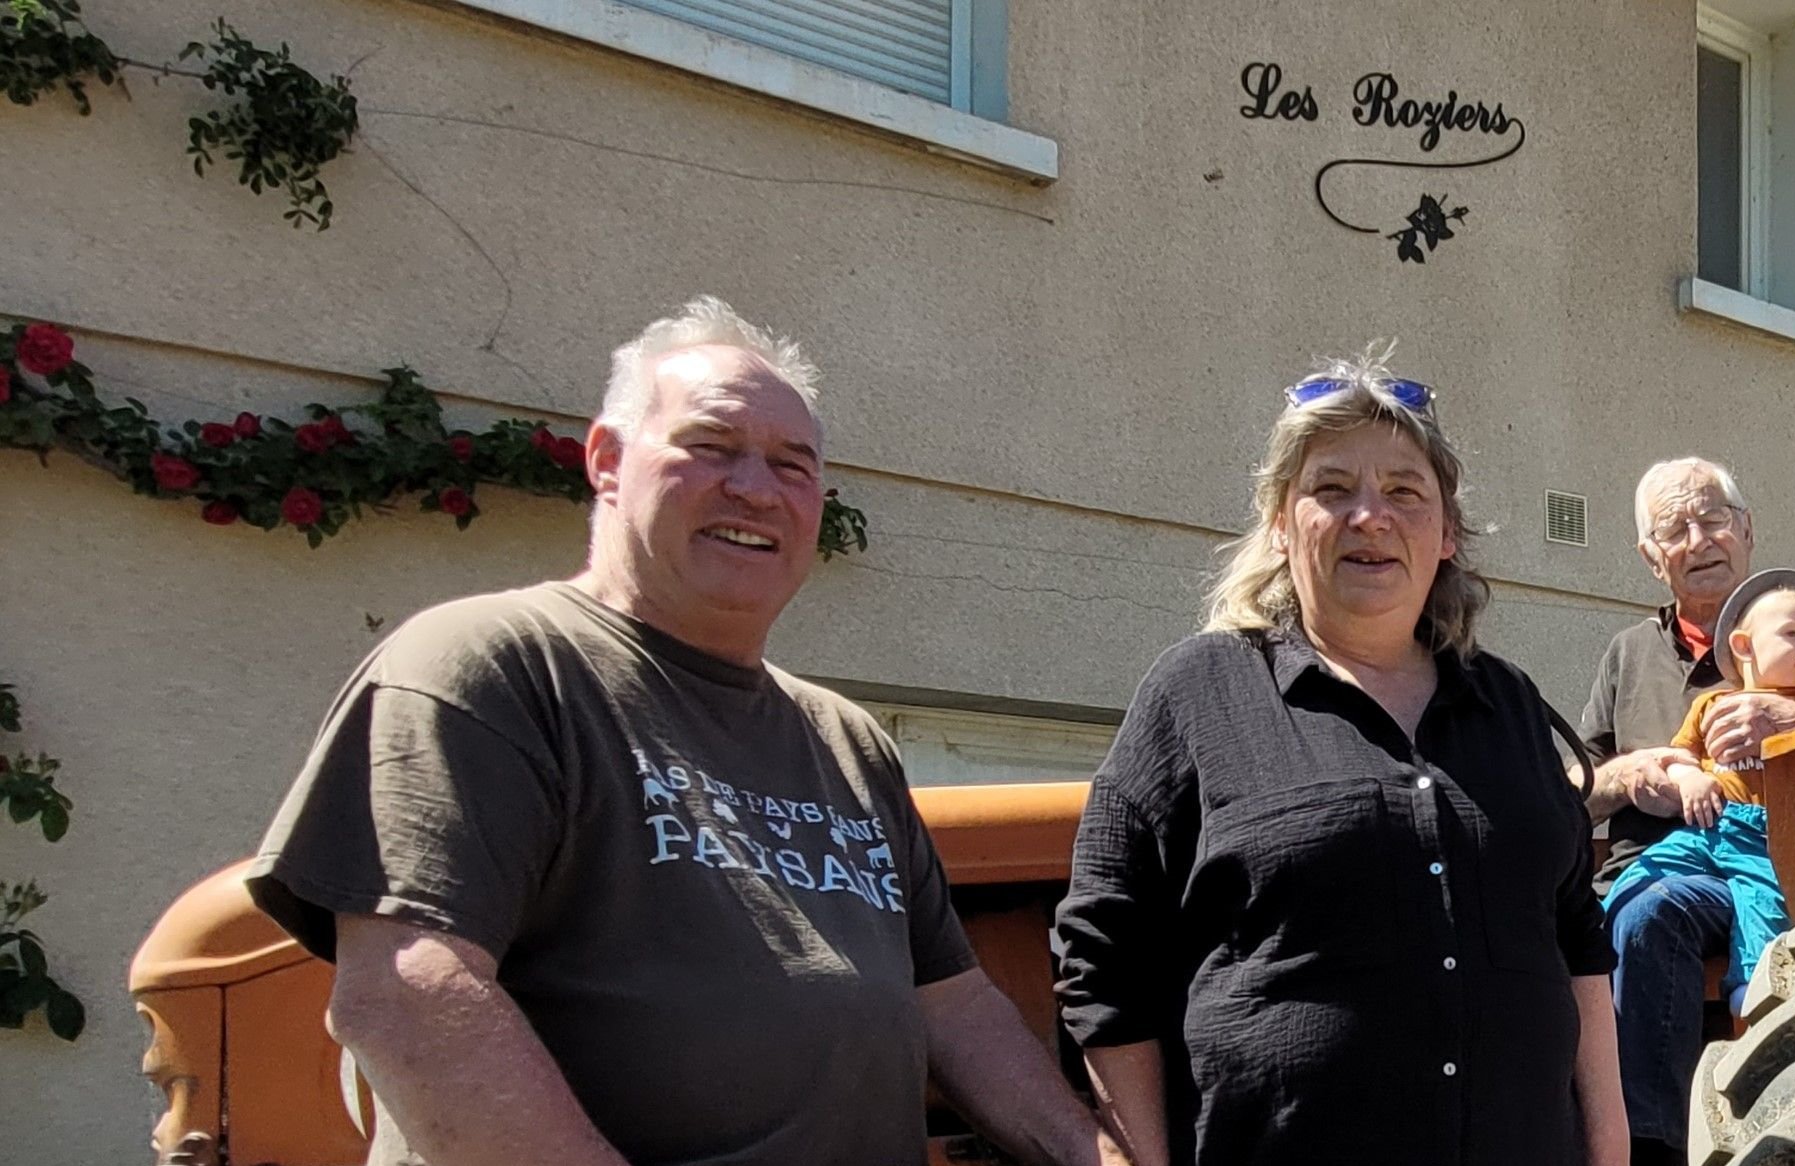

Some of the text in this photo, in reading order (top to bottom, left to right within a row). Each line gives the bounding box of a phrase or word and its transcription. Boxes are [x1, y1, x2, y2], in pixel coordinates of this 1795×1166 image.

[1240, 62, 1512, 152] Les Roziers
[645, 814, 906, 914] PAYSANS
